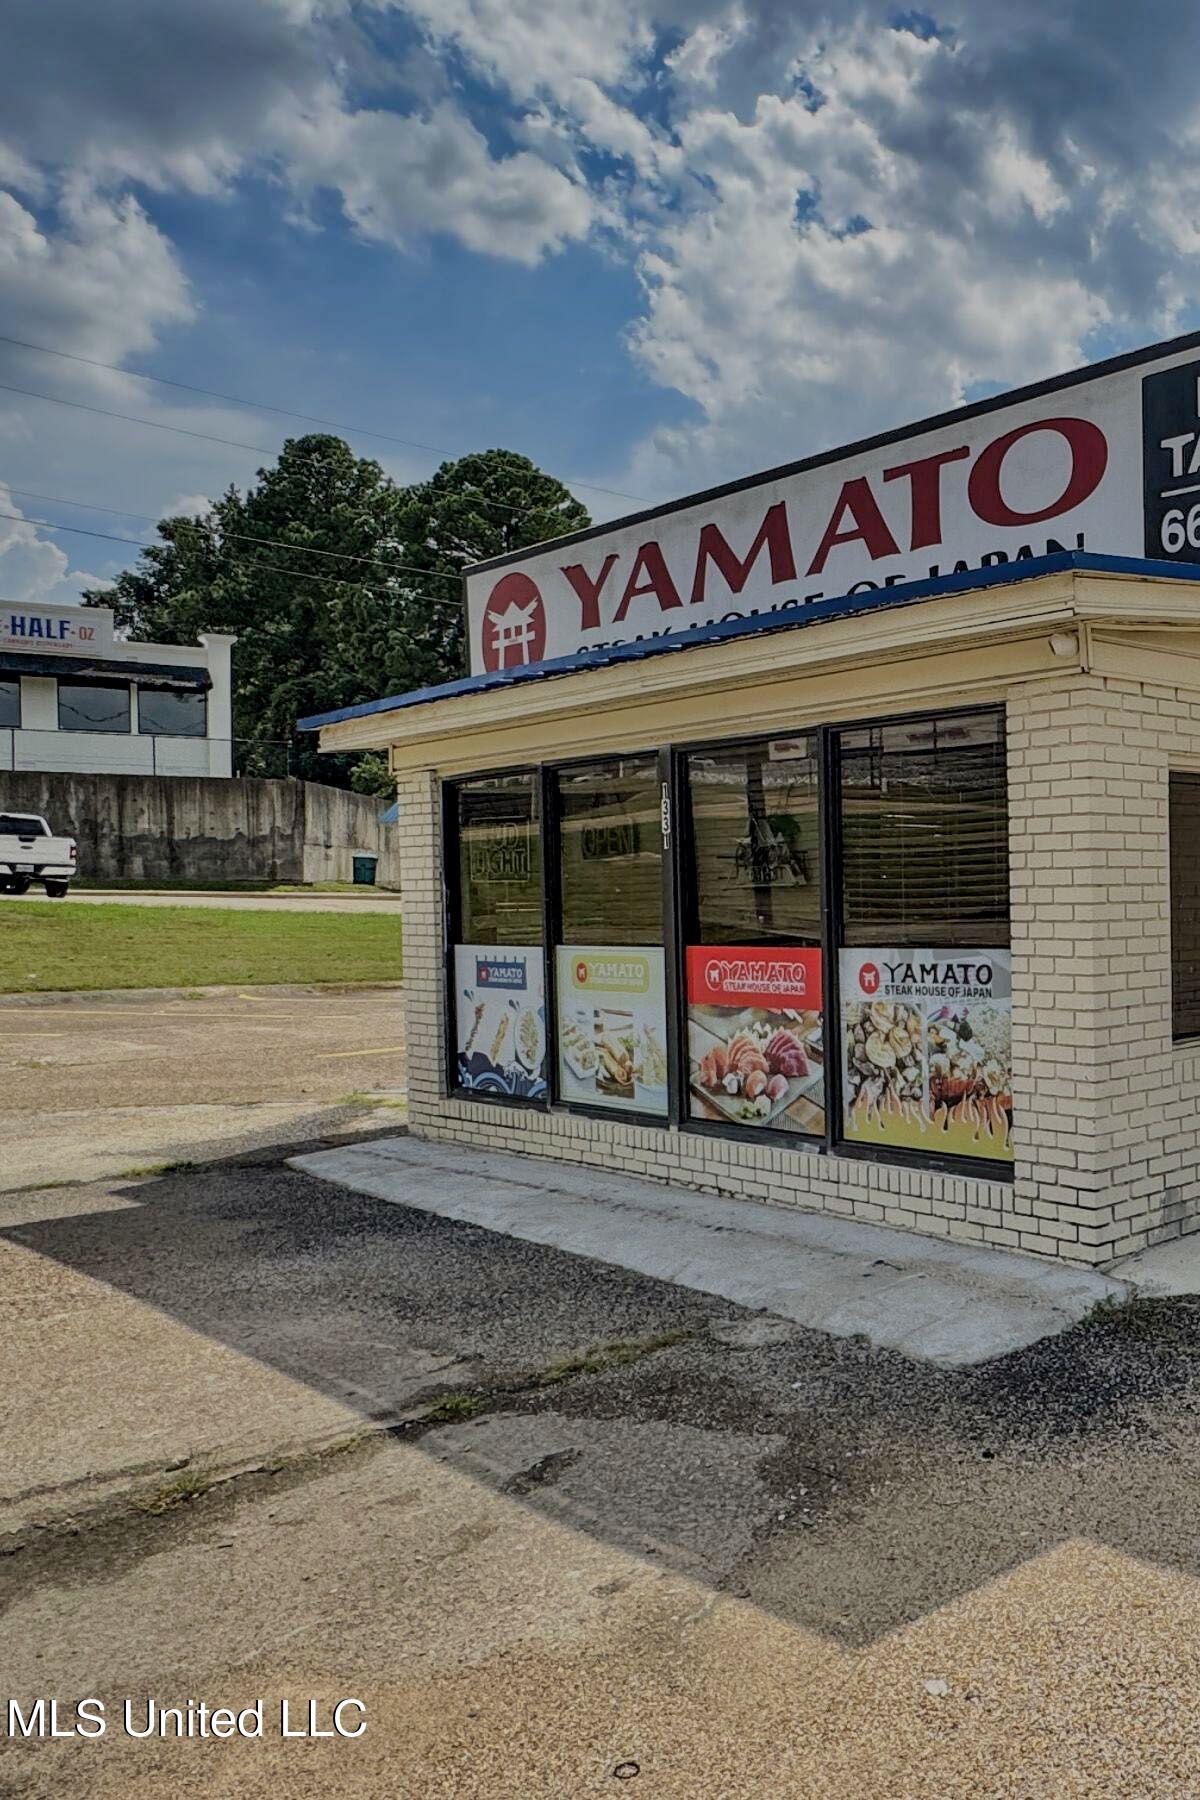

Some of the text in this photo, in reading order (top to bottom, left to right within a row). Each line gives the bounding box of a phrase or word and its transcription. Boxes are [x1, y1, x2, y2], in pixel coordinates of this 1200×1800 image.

[560, 417, 1109, 631] YAMATO
[661, 782, 671, 849] 1331
[487, 967, 523, 978] YAMATO
[588, 962, 644, 978] YAMATO
[721, 961, 806, 982] YAMATO
[883, 962, 993, 985] YAMATO
[724, 981, 805, 994] STEAK HOUSE OF JAPAN
[884, 985, 992, 998] STEAK HOUSE OF JAPAN
